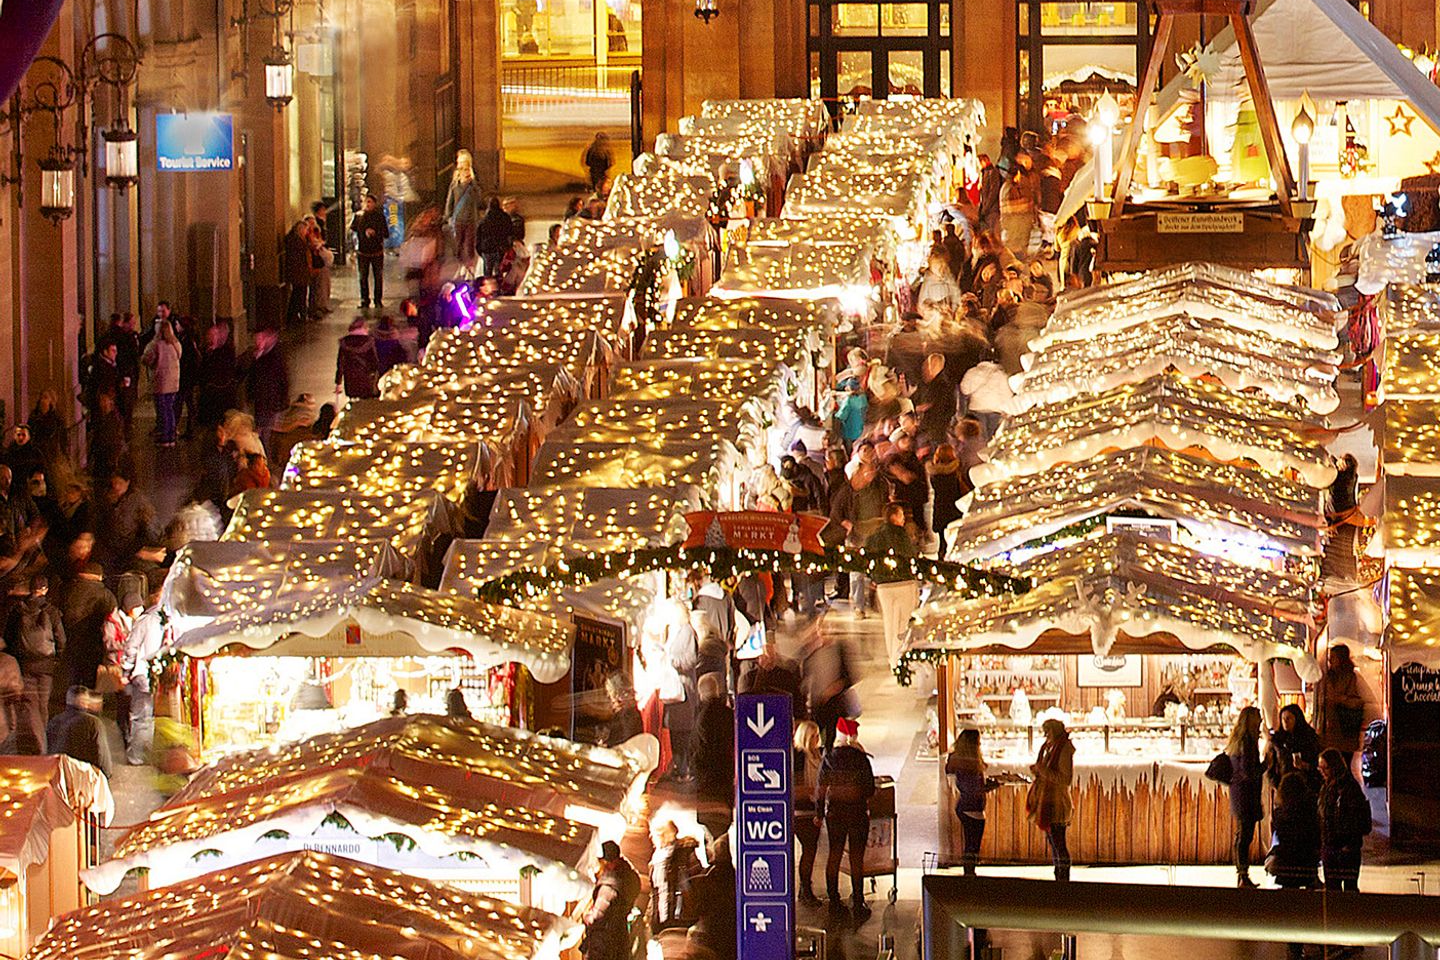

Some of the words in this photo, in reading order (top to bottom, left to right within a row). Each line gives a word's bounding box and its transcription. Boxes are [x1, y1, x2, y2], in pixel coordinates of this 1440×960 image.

[160, 156, 194, 168] Tourist
[195, 156, 231, 168] Service
[733, 531, 775, 540] MARKT
[747, 820, 783, 840] WC
